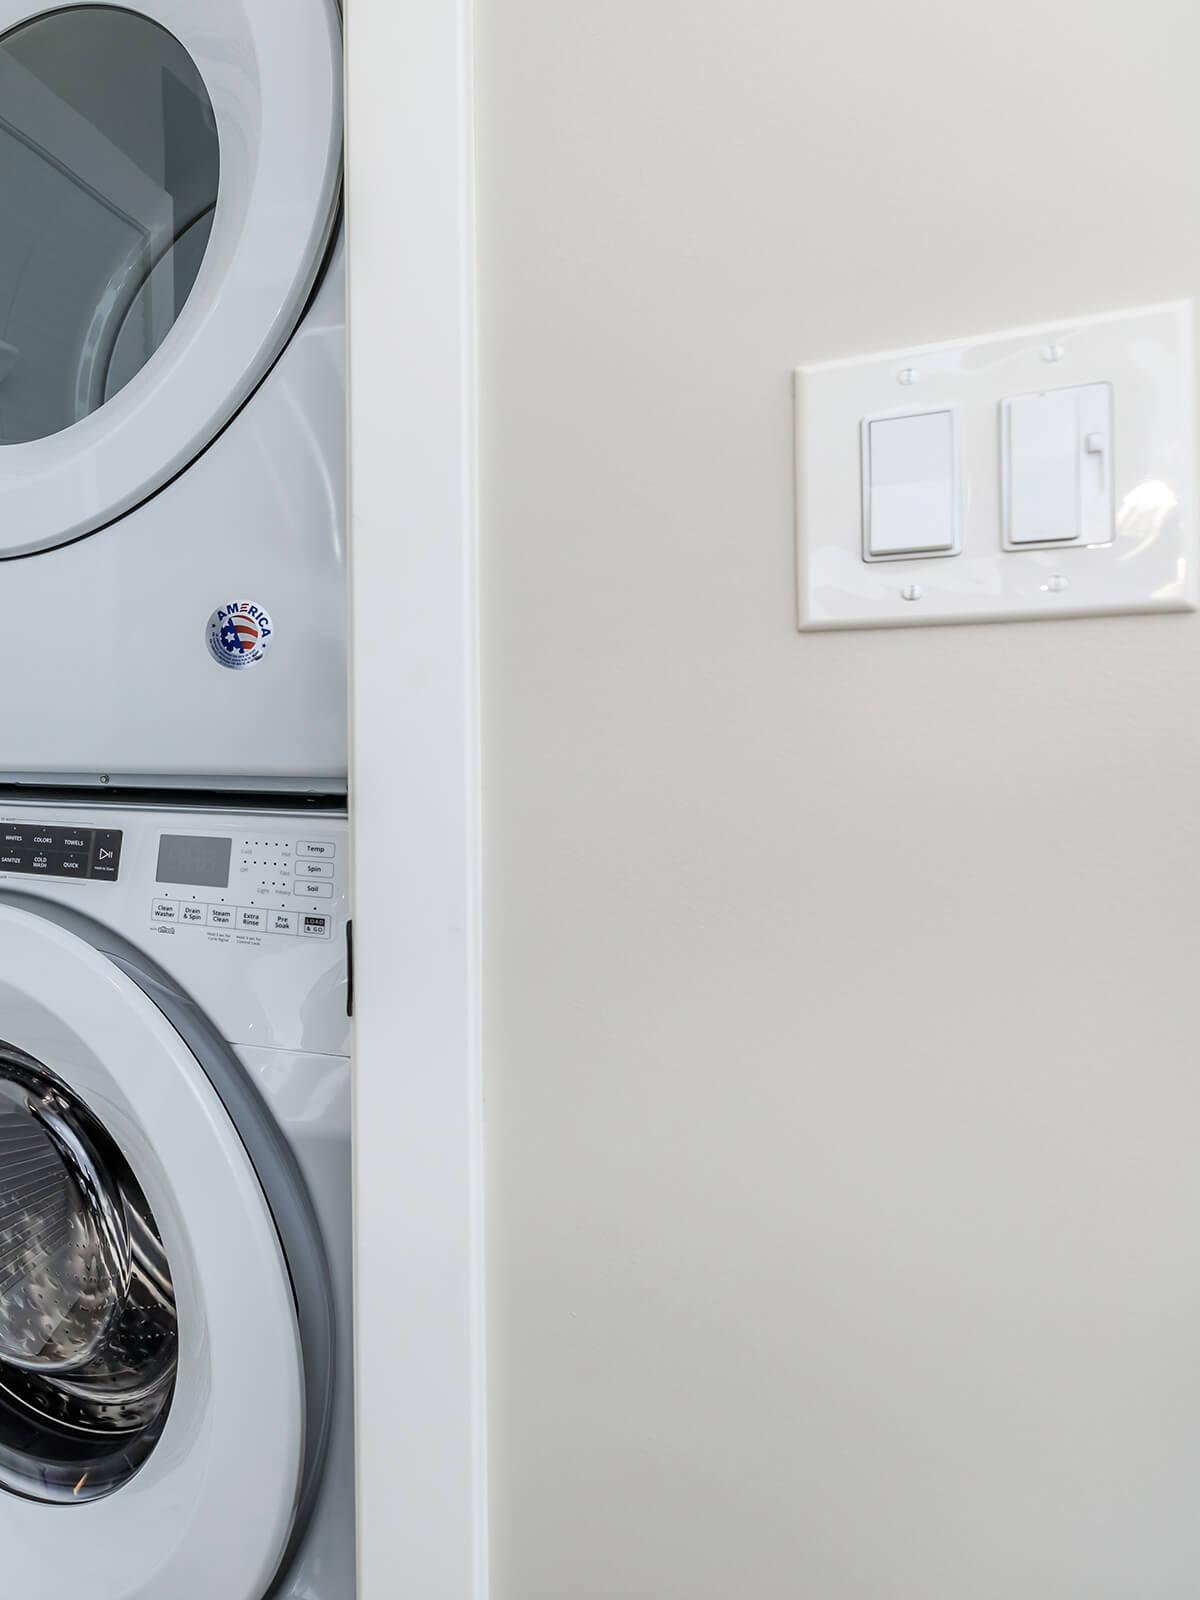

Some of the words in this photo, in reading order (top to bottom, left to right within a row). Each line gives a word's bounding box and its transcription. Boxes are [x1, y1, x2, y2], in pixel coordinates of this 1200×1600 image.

[217, 603, 271, 638] AMERICA
[307, 845, 325, 853] Temp
[189, 913, 202, 921] Spin
[243, 912, 259, 920] Extra
